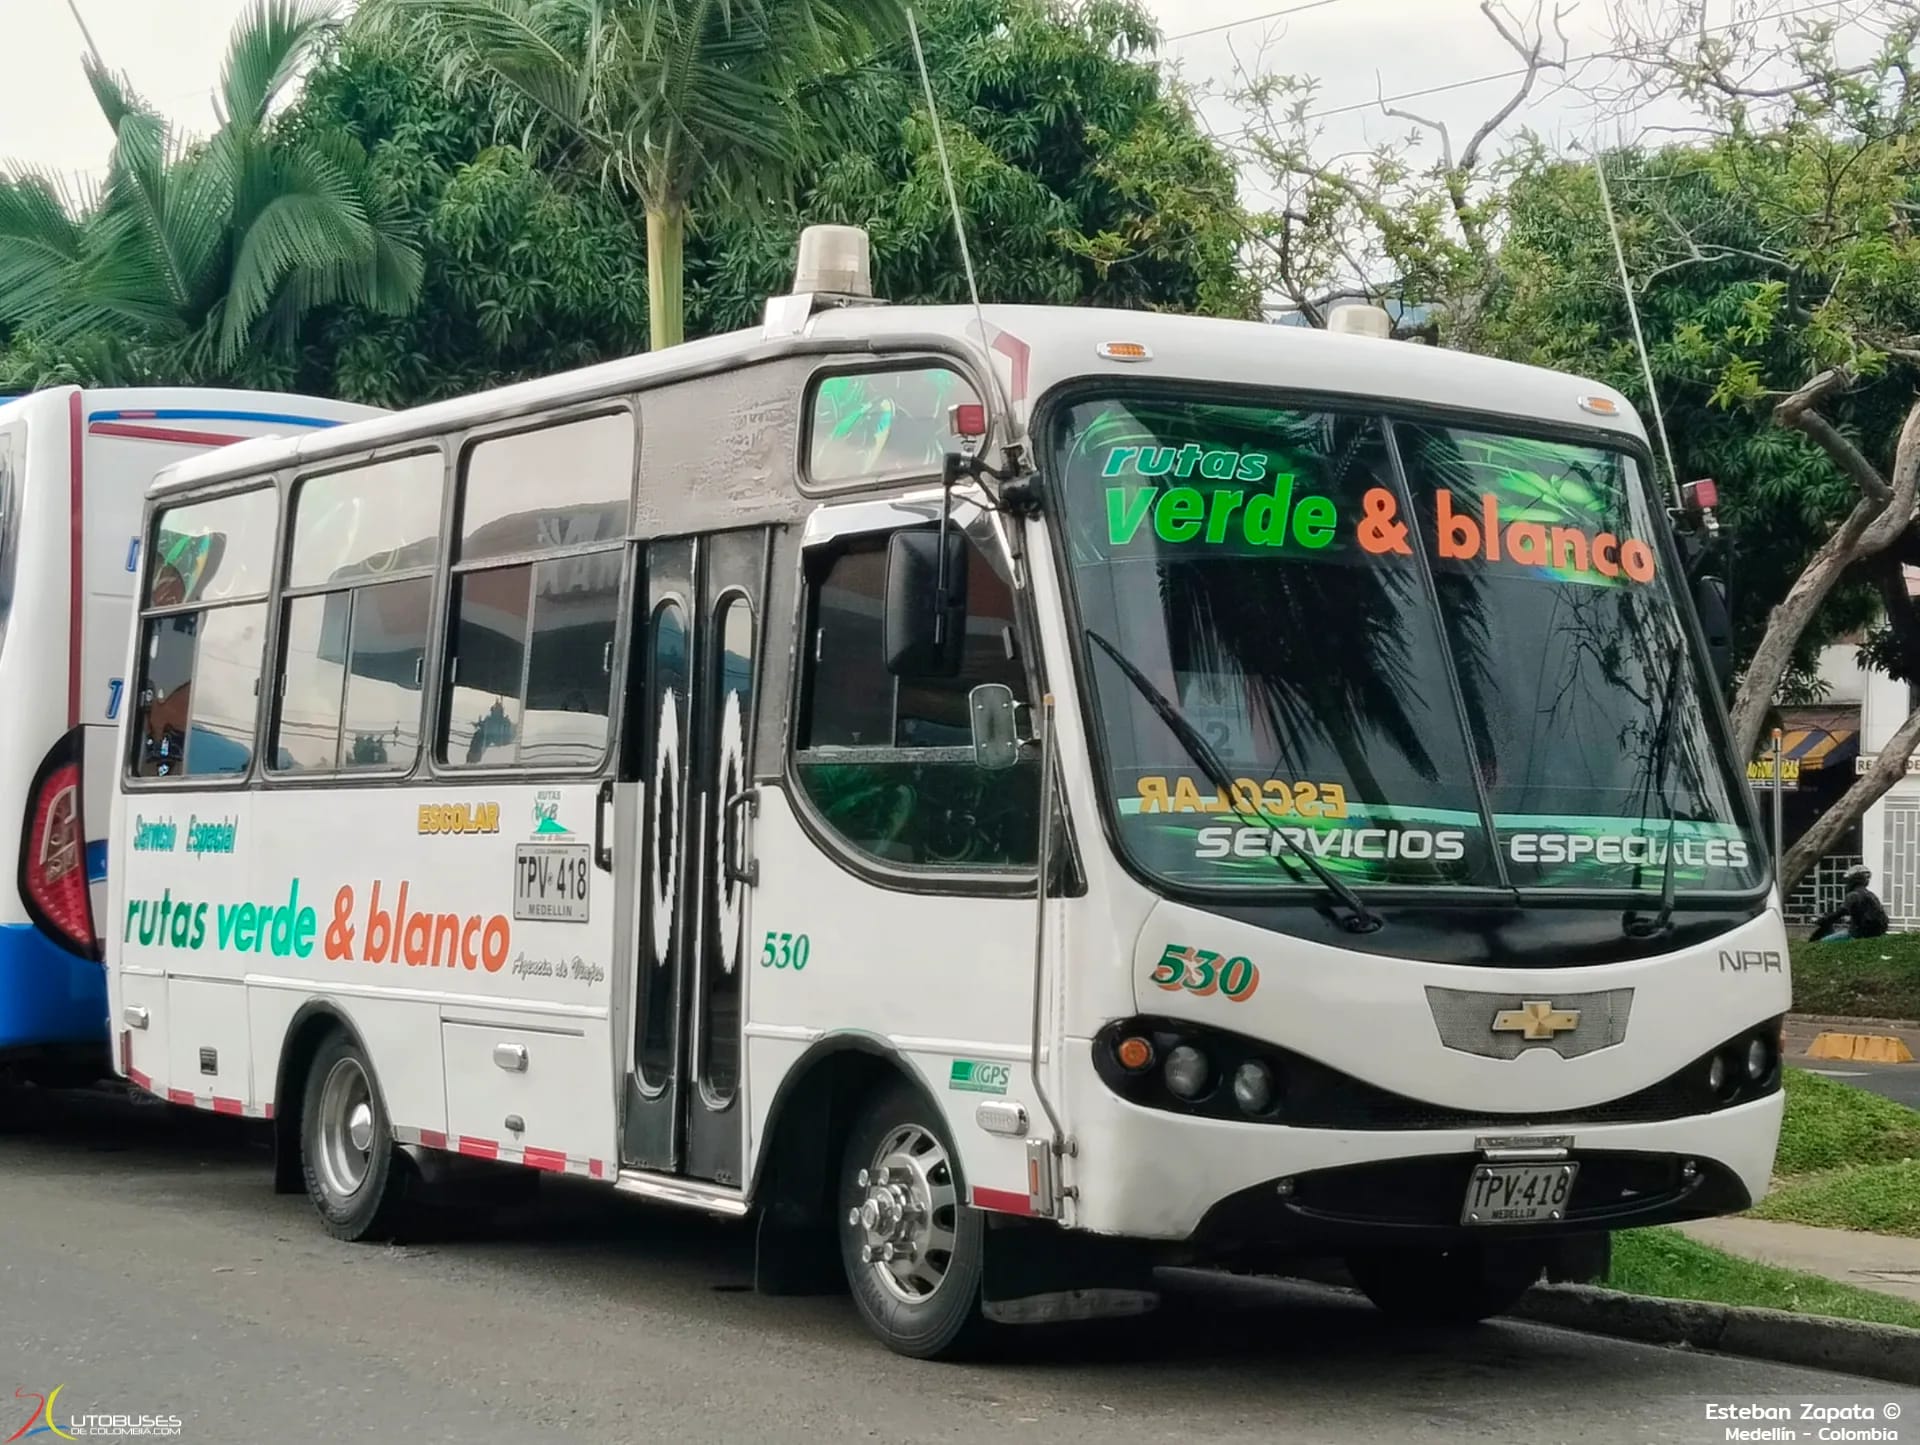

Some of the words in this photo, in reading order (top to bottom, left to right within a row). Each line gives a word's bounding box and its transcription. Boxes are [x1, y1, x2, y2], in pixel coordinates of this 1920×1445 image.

[1101, 443, 1268, 481] rutas
[1105, 473, 1337, 548] verde
[1356, 487, 1414, 554] &
[1435, 488, 1656, 584] blanco
[133, 814, 177, 851] Servicio
[186, 814, 239, 860] Especial
[418, 801, 500, 834] ESCOLAR
[1195, 827, 1465, 860] SERVICIOS
[1510, 834, 1749, 868] ESPECIALES
[124, 888, 210, 951] rutas
[216, 878, 317, 959] verde
[324, 885, 356, 962] &
[363, 880, 511, 973] blanco
[528, 903, 573, 917] MEDELLIN
[556, 960, 567, 978] de
[760, 931, 810, 971] 530
[1719, 951, 1782, 973] NPR
[1150, 944, 1260, 1002] 530
[980, 1065, 1010, 1086] GPS
